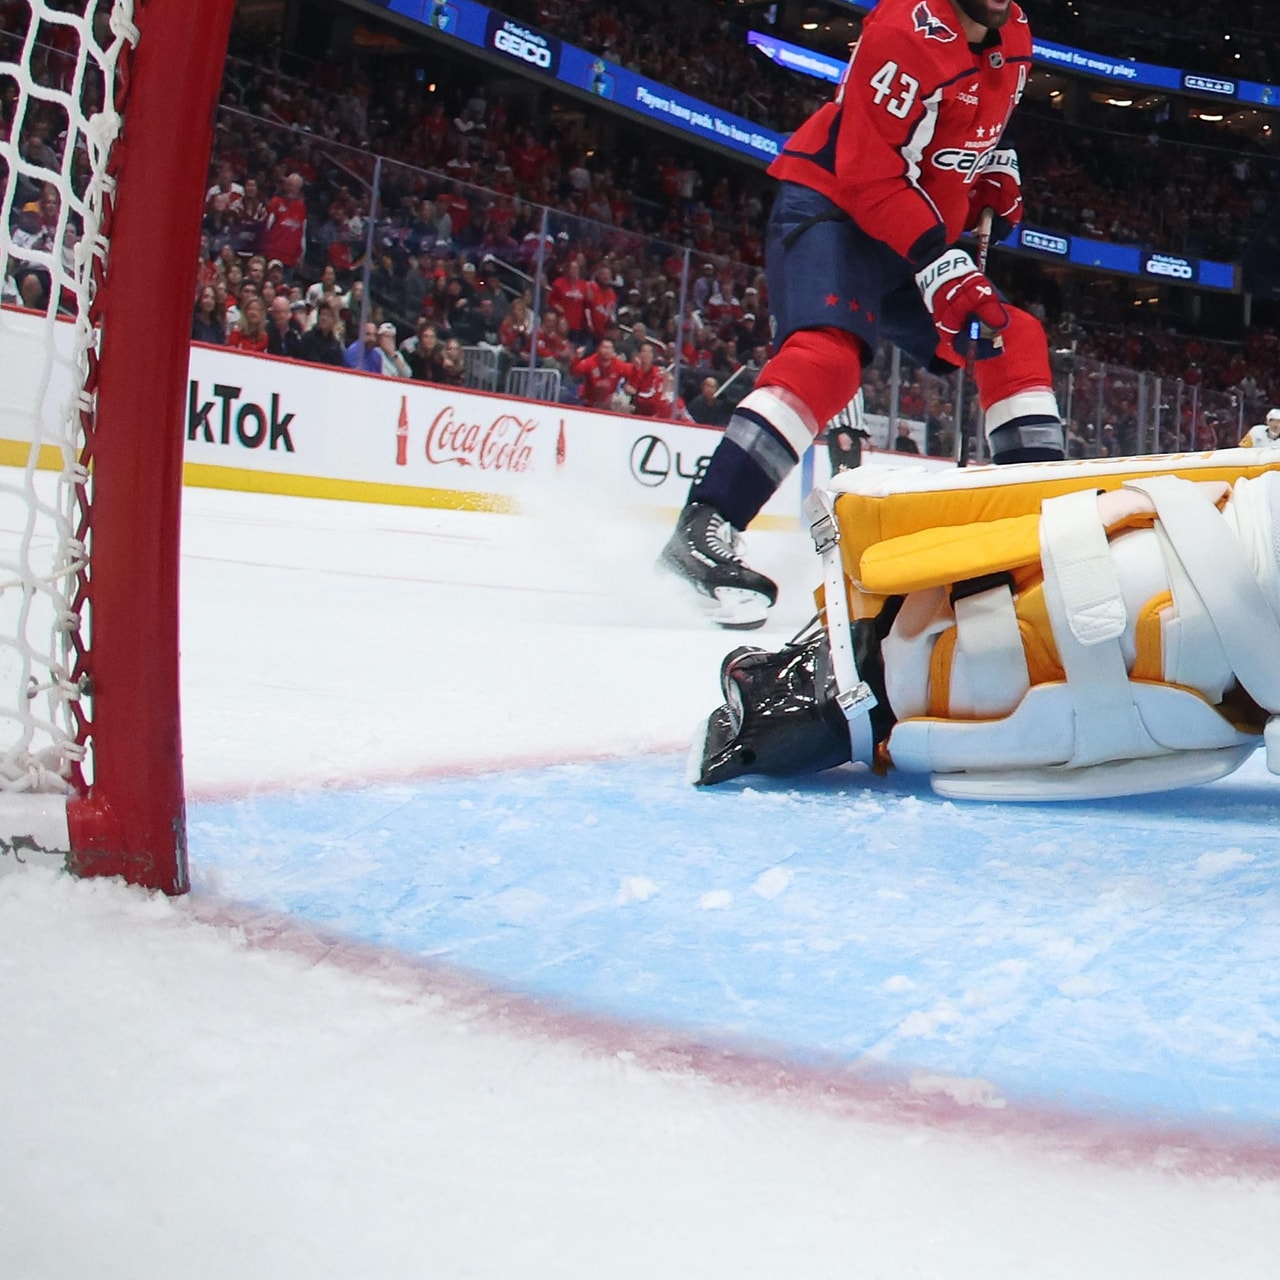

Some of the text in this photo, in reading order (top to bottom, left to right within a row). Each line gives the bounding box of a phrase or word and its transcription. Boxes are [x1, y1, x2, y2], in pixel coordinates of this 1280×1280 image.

[494, 29, 552, 68] GEICO
[870, 60, 920, 119] 43
[919, 256, 969, 291] UER
[1146, 258, 1193, 280] GEICO
[186, 381, 295, 452] kTok
